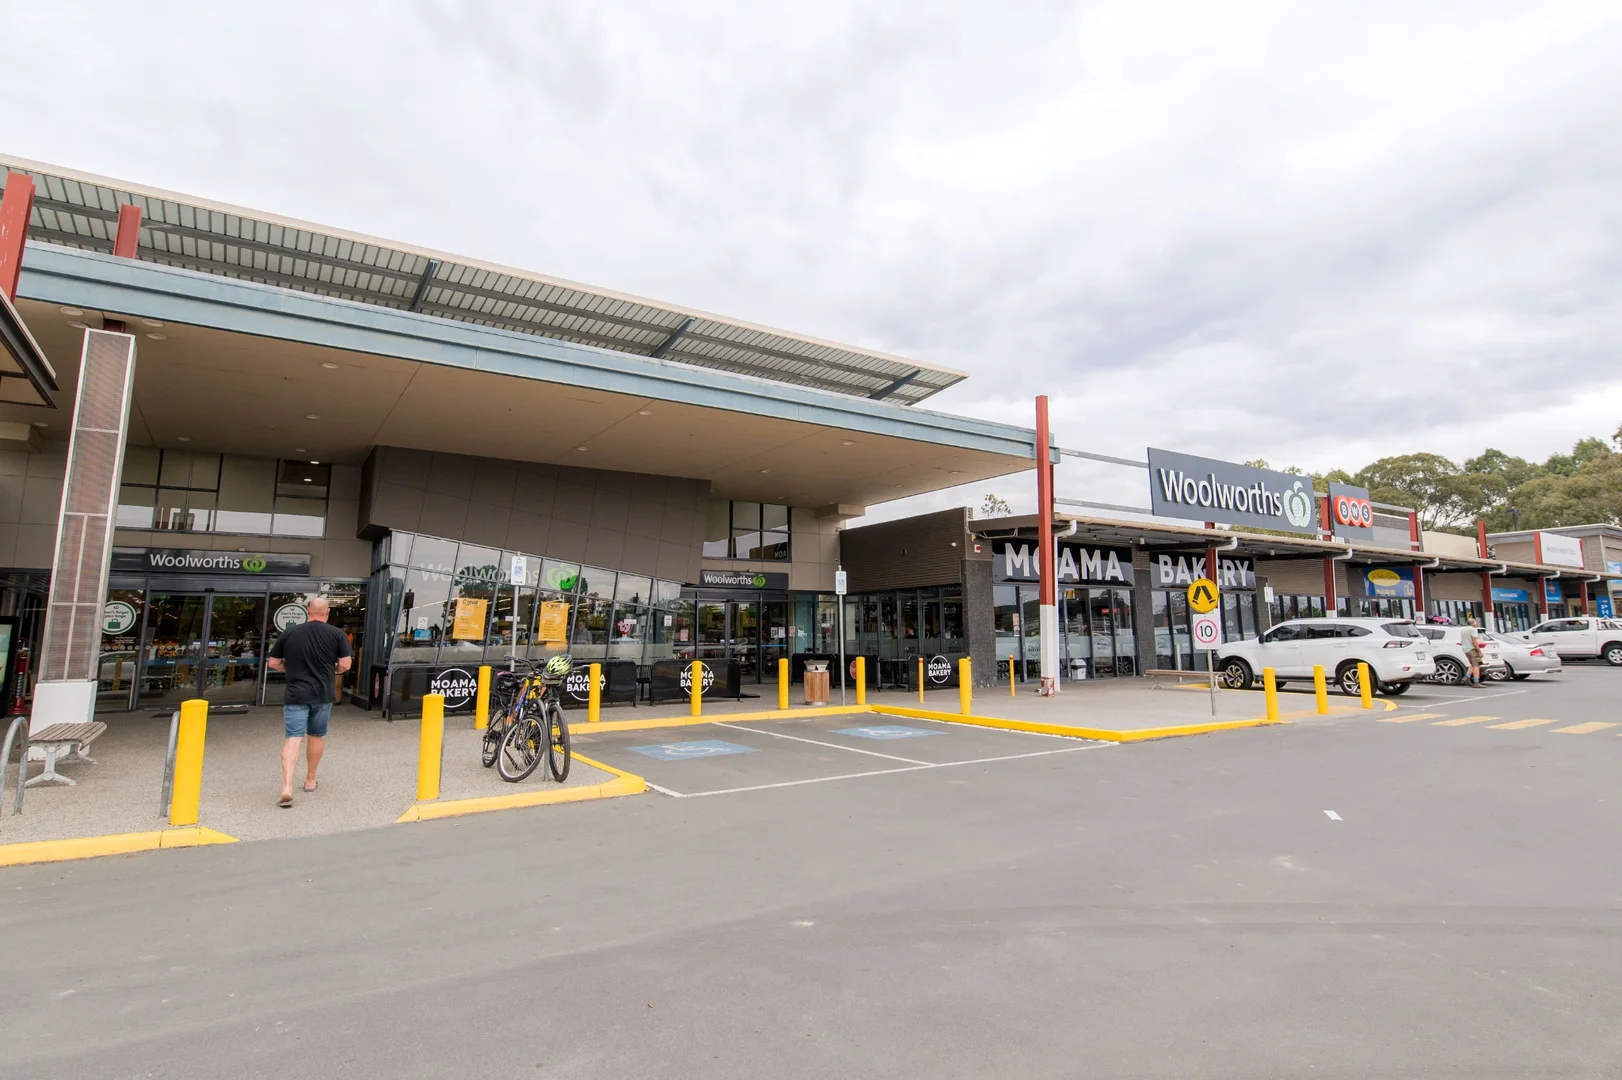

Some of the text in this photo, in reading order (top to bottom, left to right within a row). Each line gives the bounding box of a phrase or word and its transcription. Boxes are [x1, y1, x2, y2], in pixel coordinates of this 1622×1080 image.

[1159, 468, 1283, 516] Woolworths
[150, 554, 240, 569] Woolworths
[421, 562, 539, 587] Woolwors
[1159, 554, 1249, 587] BAKRY
[704, 574, 752, 585] Woolworths
[1200, 625, 1213, 638] 10
[680, 671, 715, 680] MOMA
[928, 669, 952, 677] BAKERY
[431, 678, 477, 689] MOAMA
[566, 674, 606, 684] MOAA
[680, 678, 715, 688] BARY
[566, 682, 606, 692] BAKEY
